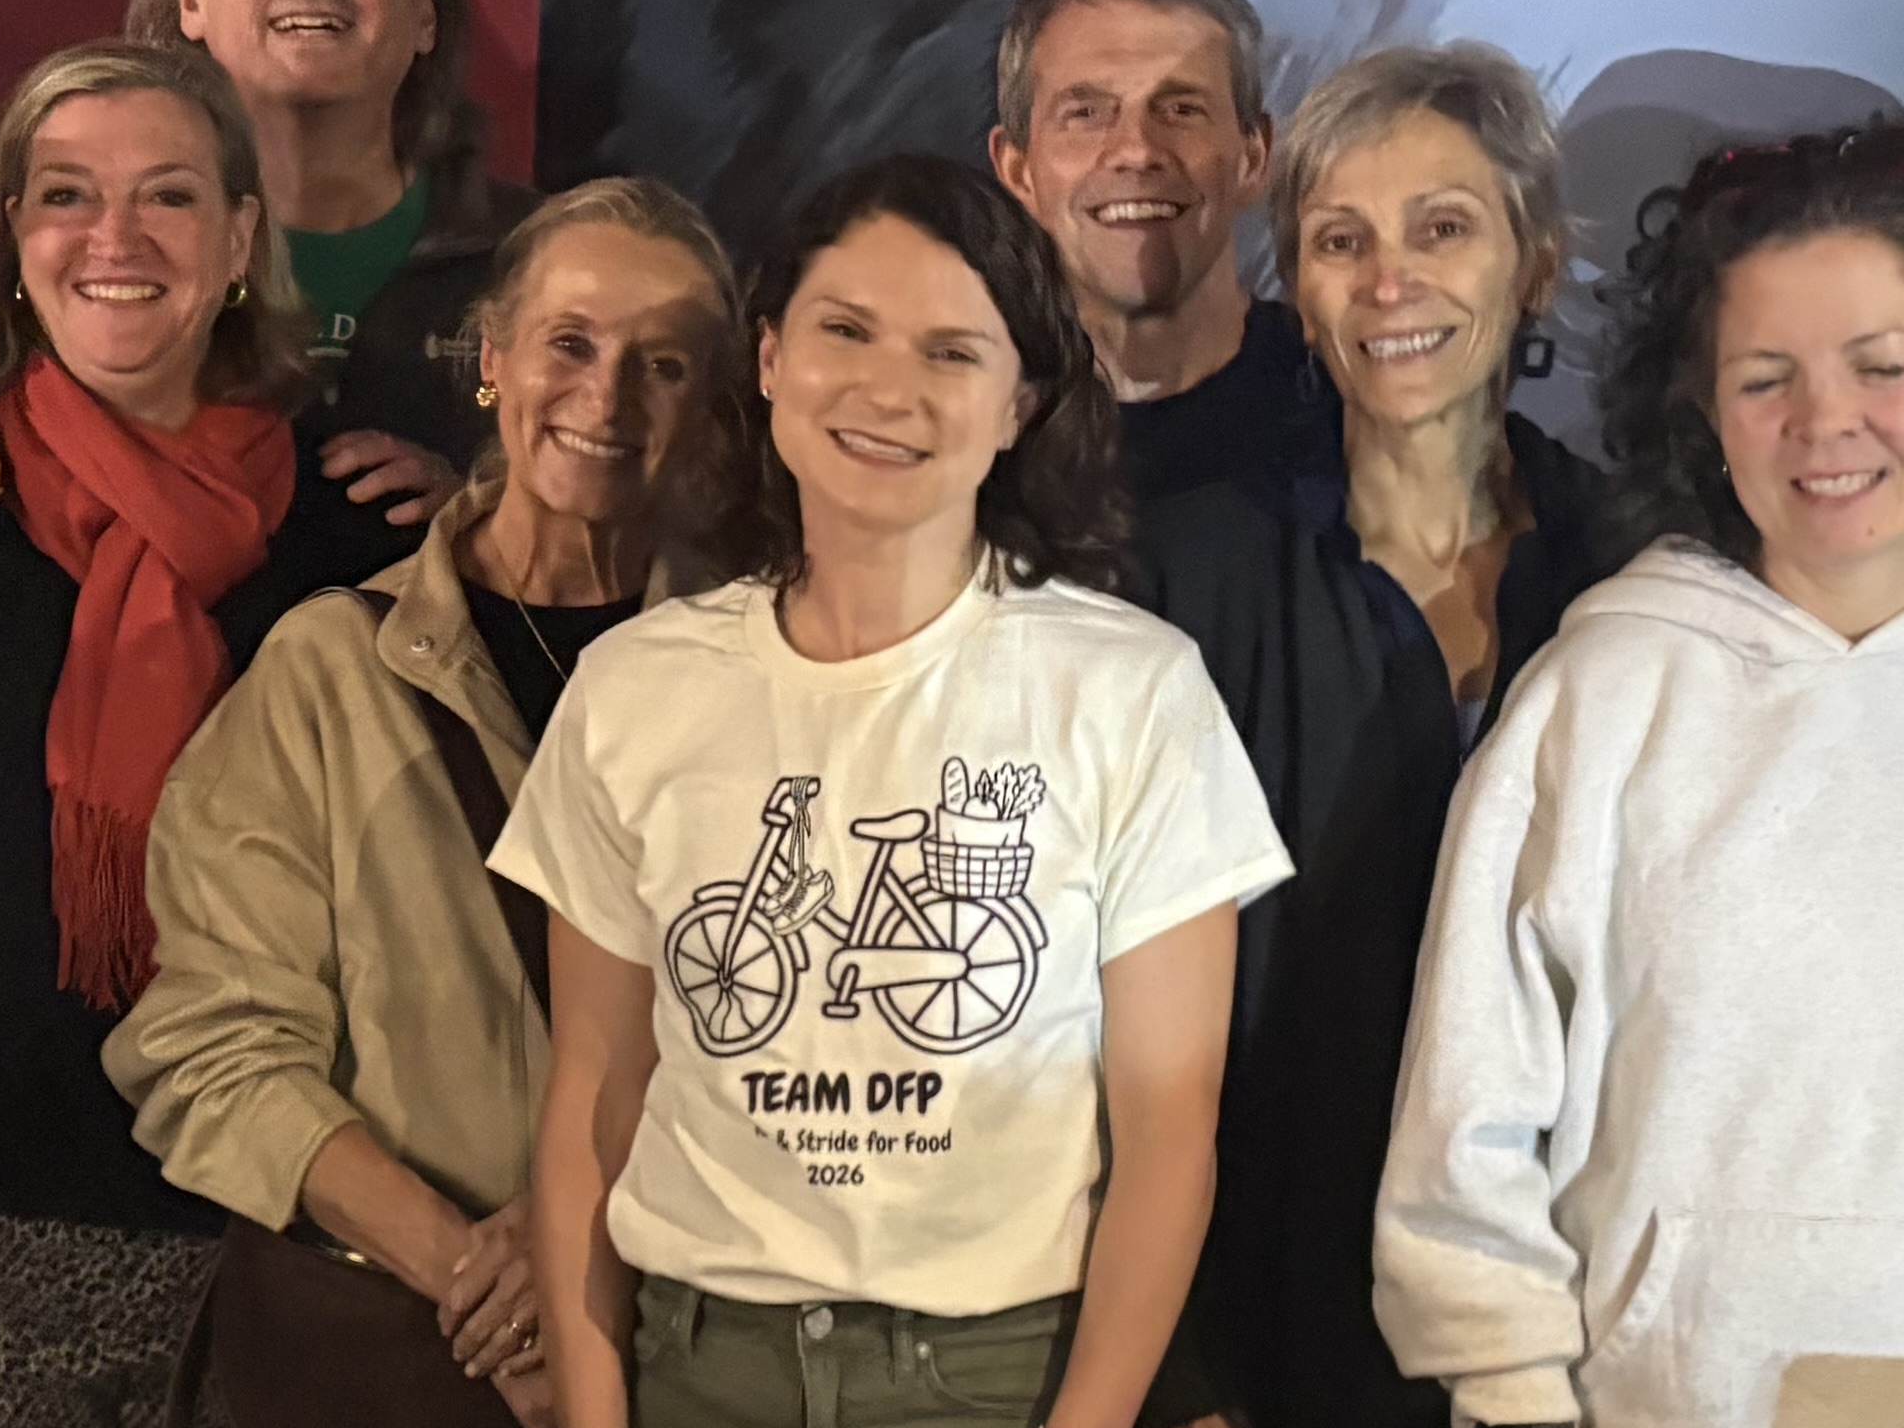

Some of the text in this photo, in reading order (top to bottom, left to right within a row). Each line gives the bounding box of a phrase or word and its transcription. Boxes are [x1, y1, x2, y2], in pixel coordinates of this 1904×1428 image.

[741, 1071, 944, 1116] TEAM DFP
[796, 1127, 859, 1153] Stride
[867, 1129, 898, 1154] for
[904, 1128, 952, 1154] Food
[807, 1164, 865, 1186] 2026
